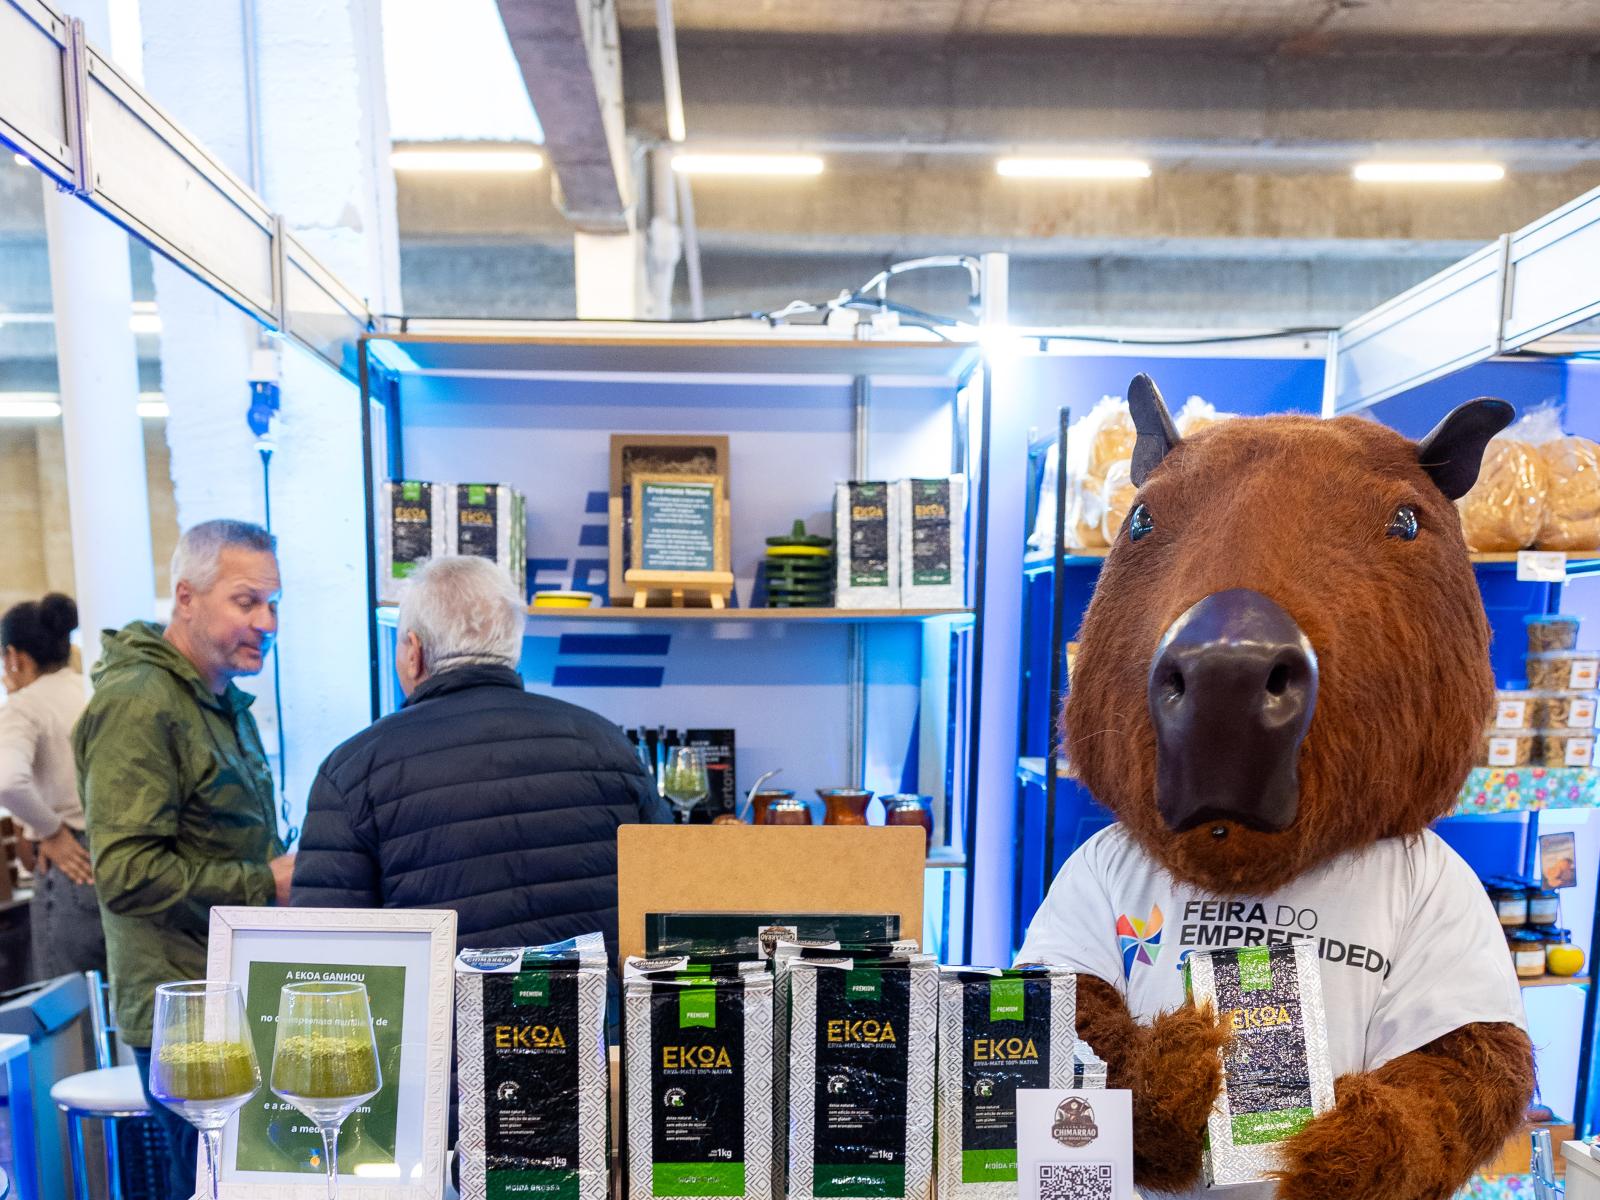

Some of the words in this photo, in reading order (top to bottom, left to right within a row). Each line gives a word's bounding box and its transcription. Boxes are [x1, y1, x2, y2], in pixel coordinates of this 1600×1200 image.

[1183, 901, 1268, 925] FEIRA
[1275, 905, 1318, 930] DO
[286, 971, 293, 980] A
[295, 972, 322, 980] EKOA
[322, 972, 365, 982] GANHOU
[260, 1015, 273, 1023] no
[376, 1018, 388, 1026] de
[1231, 1006, 1291, 1028] EKOA
[495, 1025, 566, 1048] EKOA
[827, 1019, 896, 1042] EKOA
[662, 1045, 733, 1068] EKOA
[973, 1037, 1039, 1060] EKOA
[552, 1156, 567, 1166] 1kg
[717, 1148, 732, 1158] 1kg
[879, 1150, 893, 1160] 1kg
